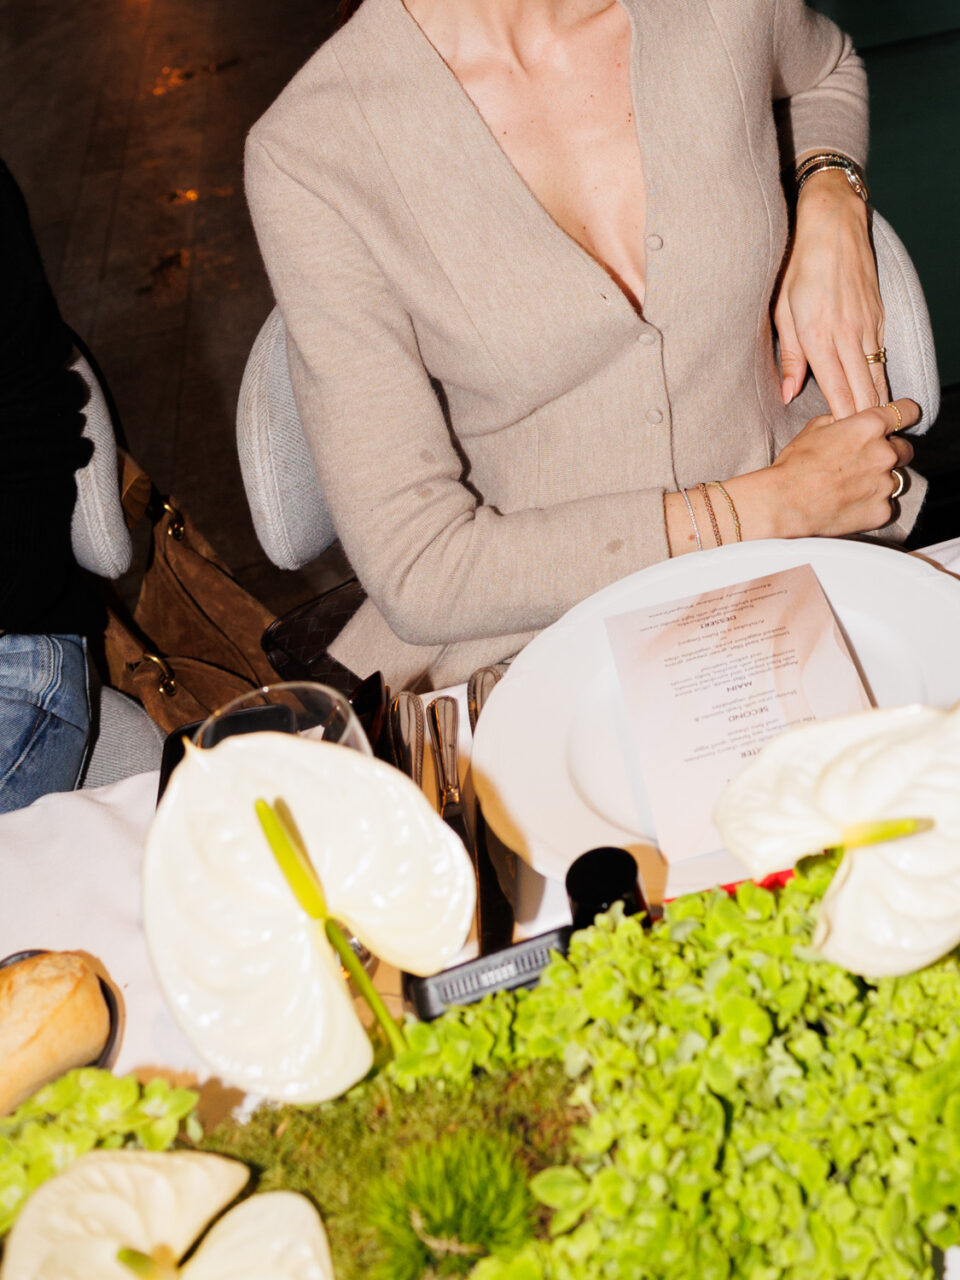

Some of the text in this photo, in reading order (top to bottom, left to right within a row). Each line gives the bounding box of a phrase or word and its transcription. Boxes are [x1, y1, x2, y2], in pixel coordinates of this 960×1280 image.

[699, 614, 737, 629] DESSERT
[725, 680, 753, 692] MAIN
[727, 705, 768, 722] SECOND
